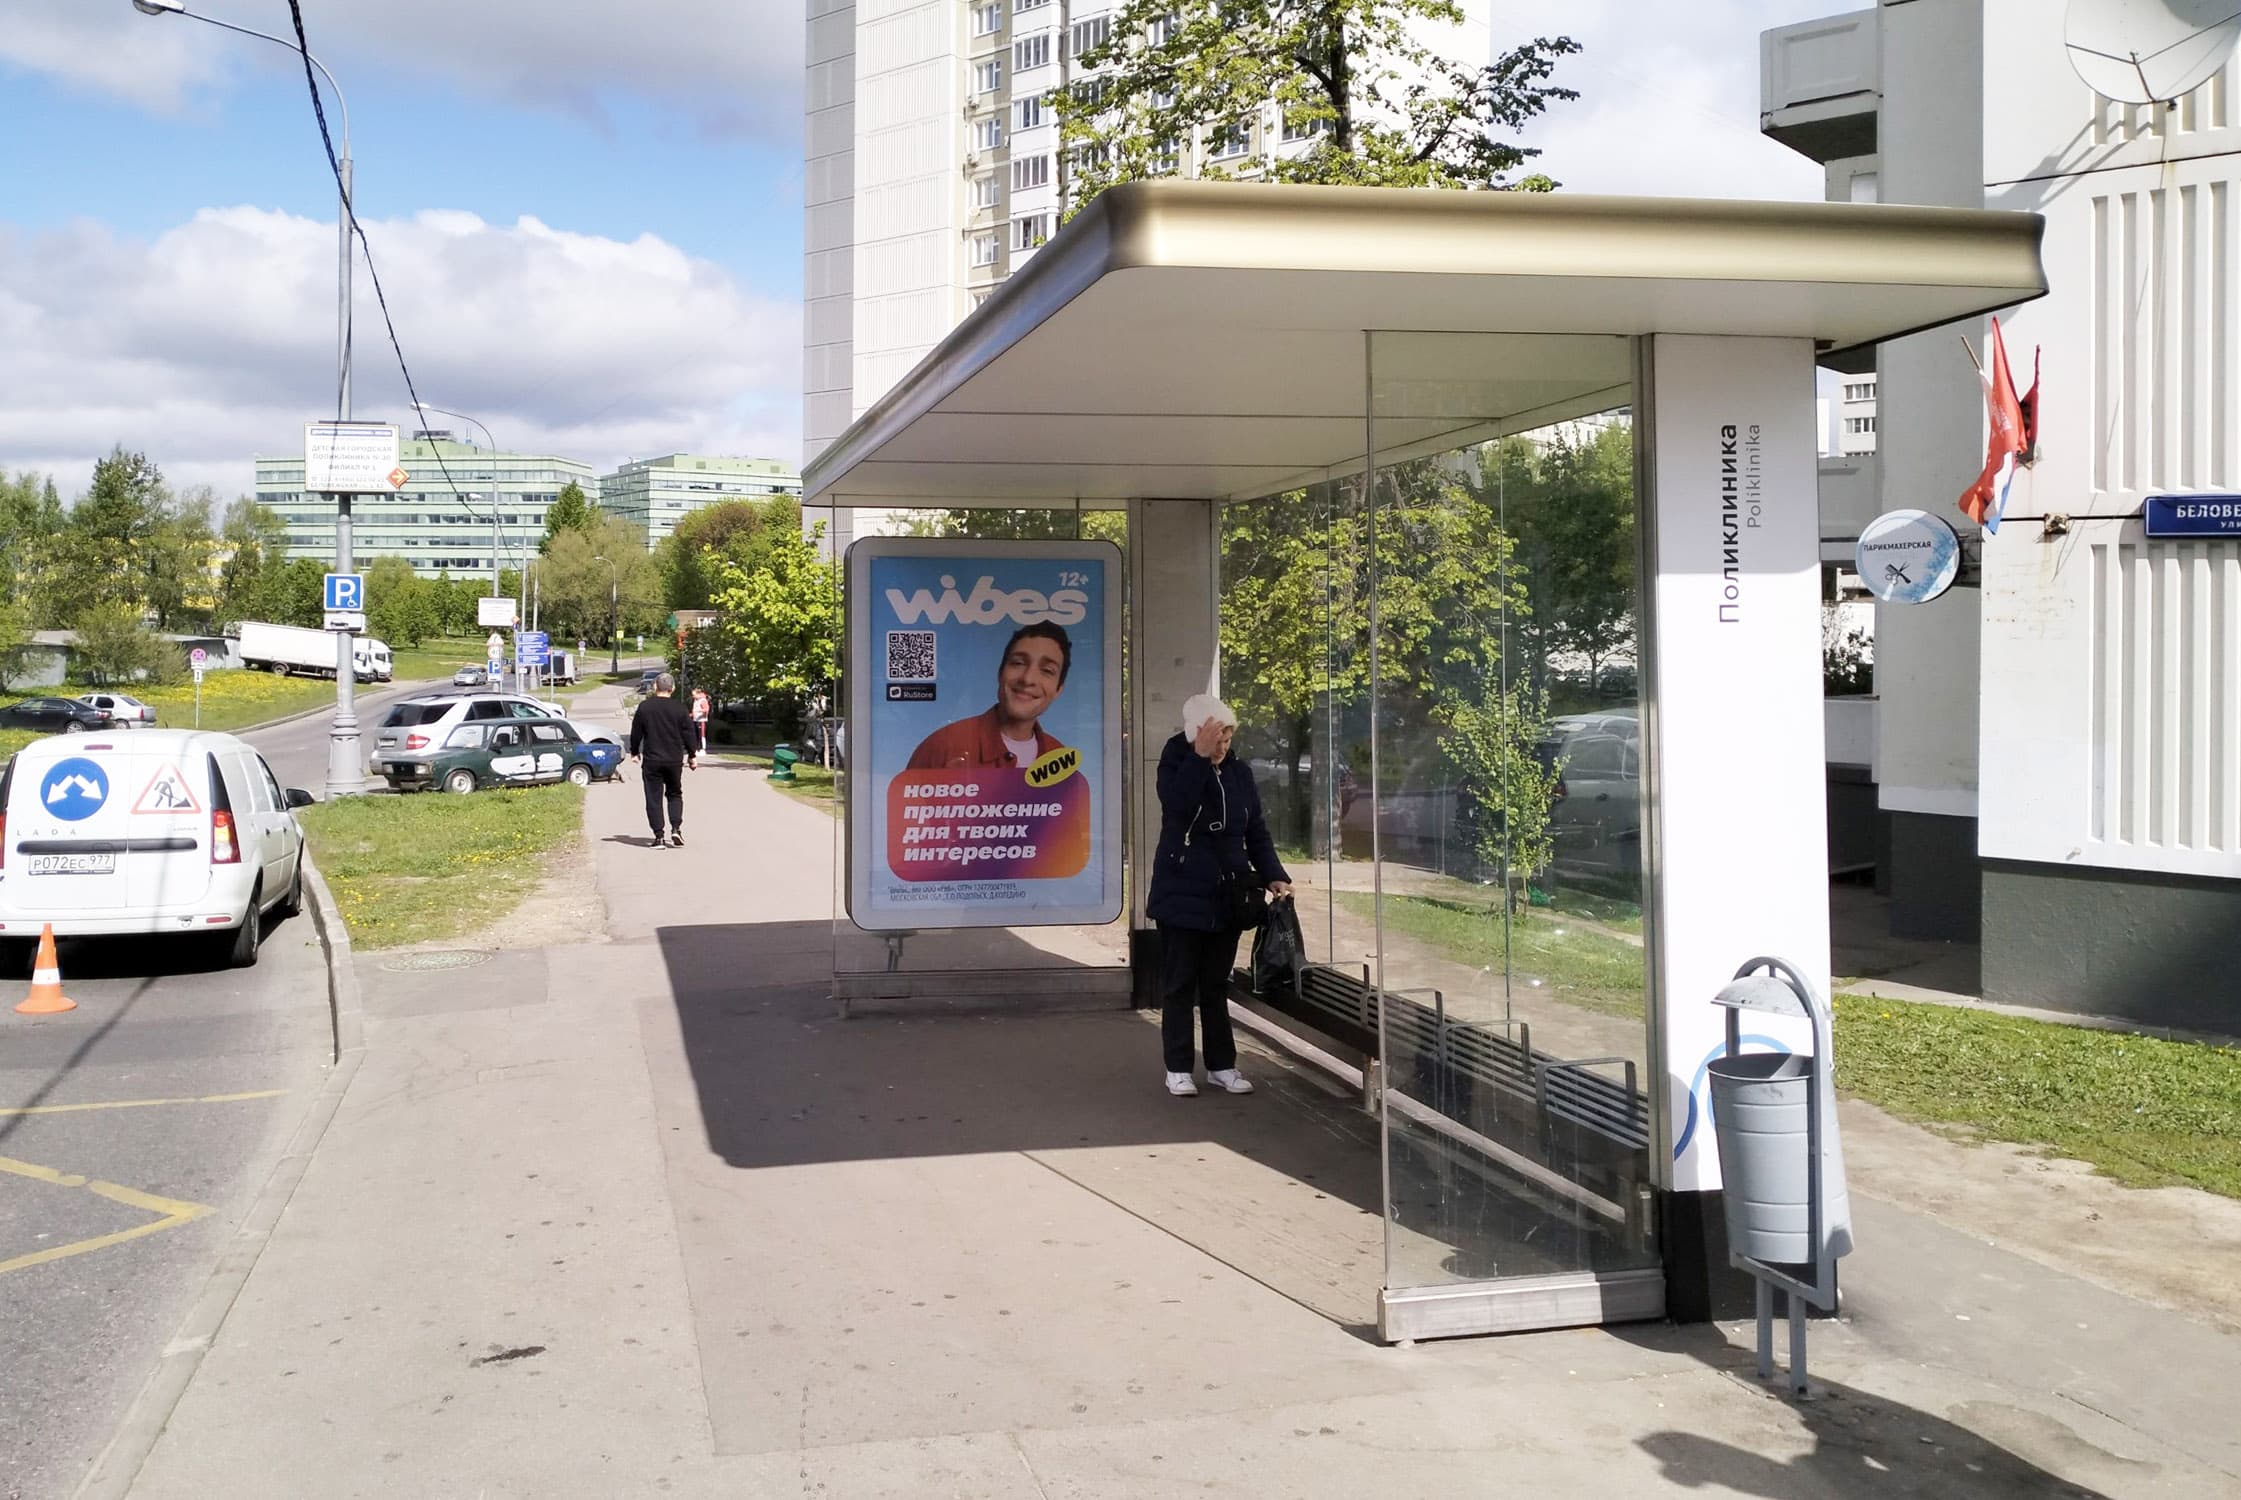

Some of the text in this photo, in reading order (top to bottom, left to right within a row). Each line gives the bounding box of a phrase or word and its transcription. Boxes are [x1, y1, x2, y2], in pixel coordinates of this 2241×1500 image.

[1745, 424, 1761, 528] Poliklinika
[2176, 504, 2241, 518] БЕЛОВЕ
[1719, 424, 1740, 623] Поликлиника
[1863, 541, 1932, 552] ПАРИКМАХЕРСКАЯ
[1058, 571, 1089, 587] 12+
[885, 574, 1089, 626] wibes
[903, 783, 980, 798] новое
[903, 803, 1062, 824] приложение
[17, 828, 76, 837] LADA
[902, 824, 1029, 844] для твоих
[903, 845, 1036, 865] интересов
